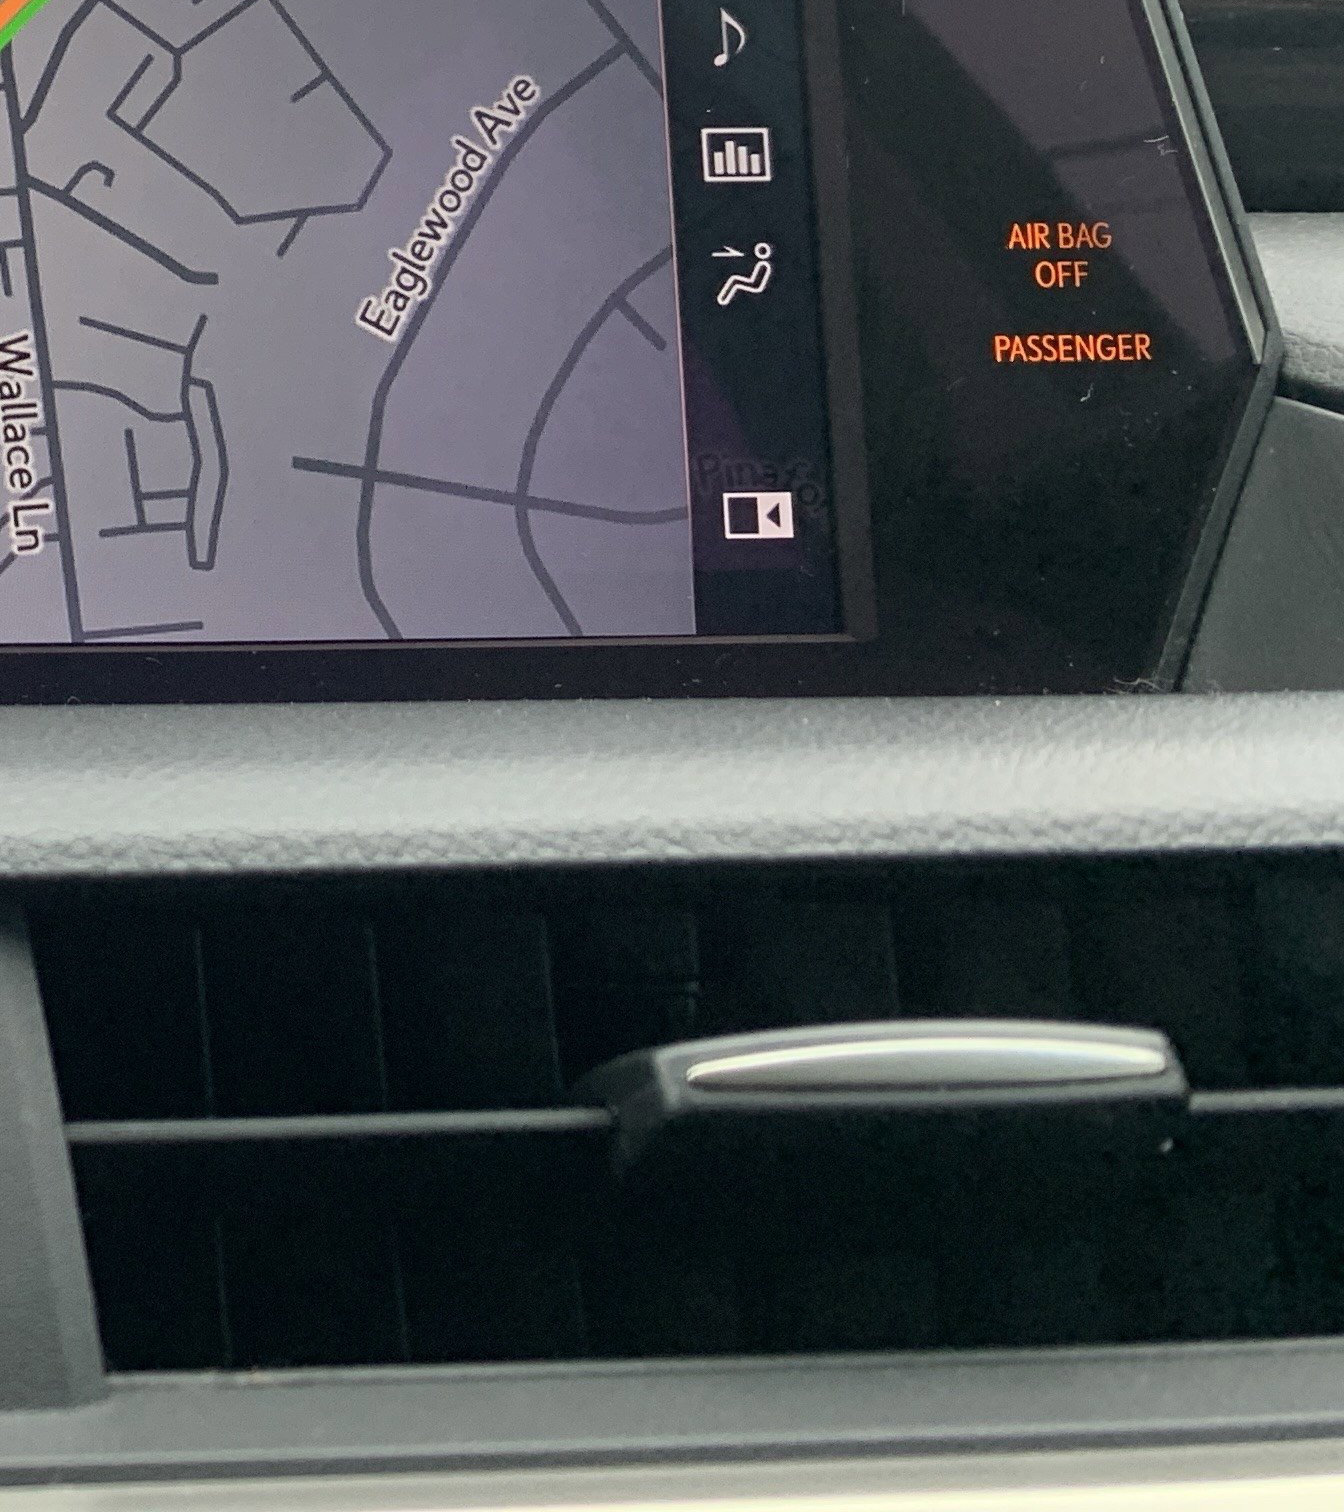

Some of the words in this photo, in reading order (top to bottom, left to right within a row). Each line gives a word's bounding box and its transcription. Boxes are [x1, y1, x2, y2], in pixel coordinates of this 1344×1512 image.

[359, 138, 488, 337] Eaglewood
[473, 78, 537, 146] Ave
[1007, 221, 1051, 250] AIR
[1057, 221, 1113, 250] BAG
[1034, 260, 1089, 289] OFF
[993, 333, 1153, 363] PASSENGER
[12, 503, 50, 552] Ln
